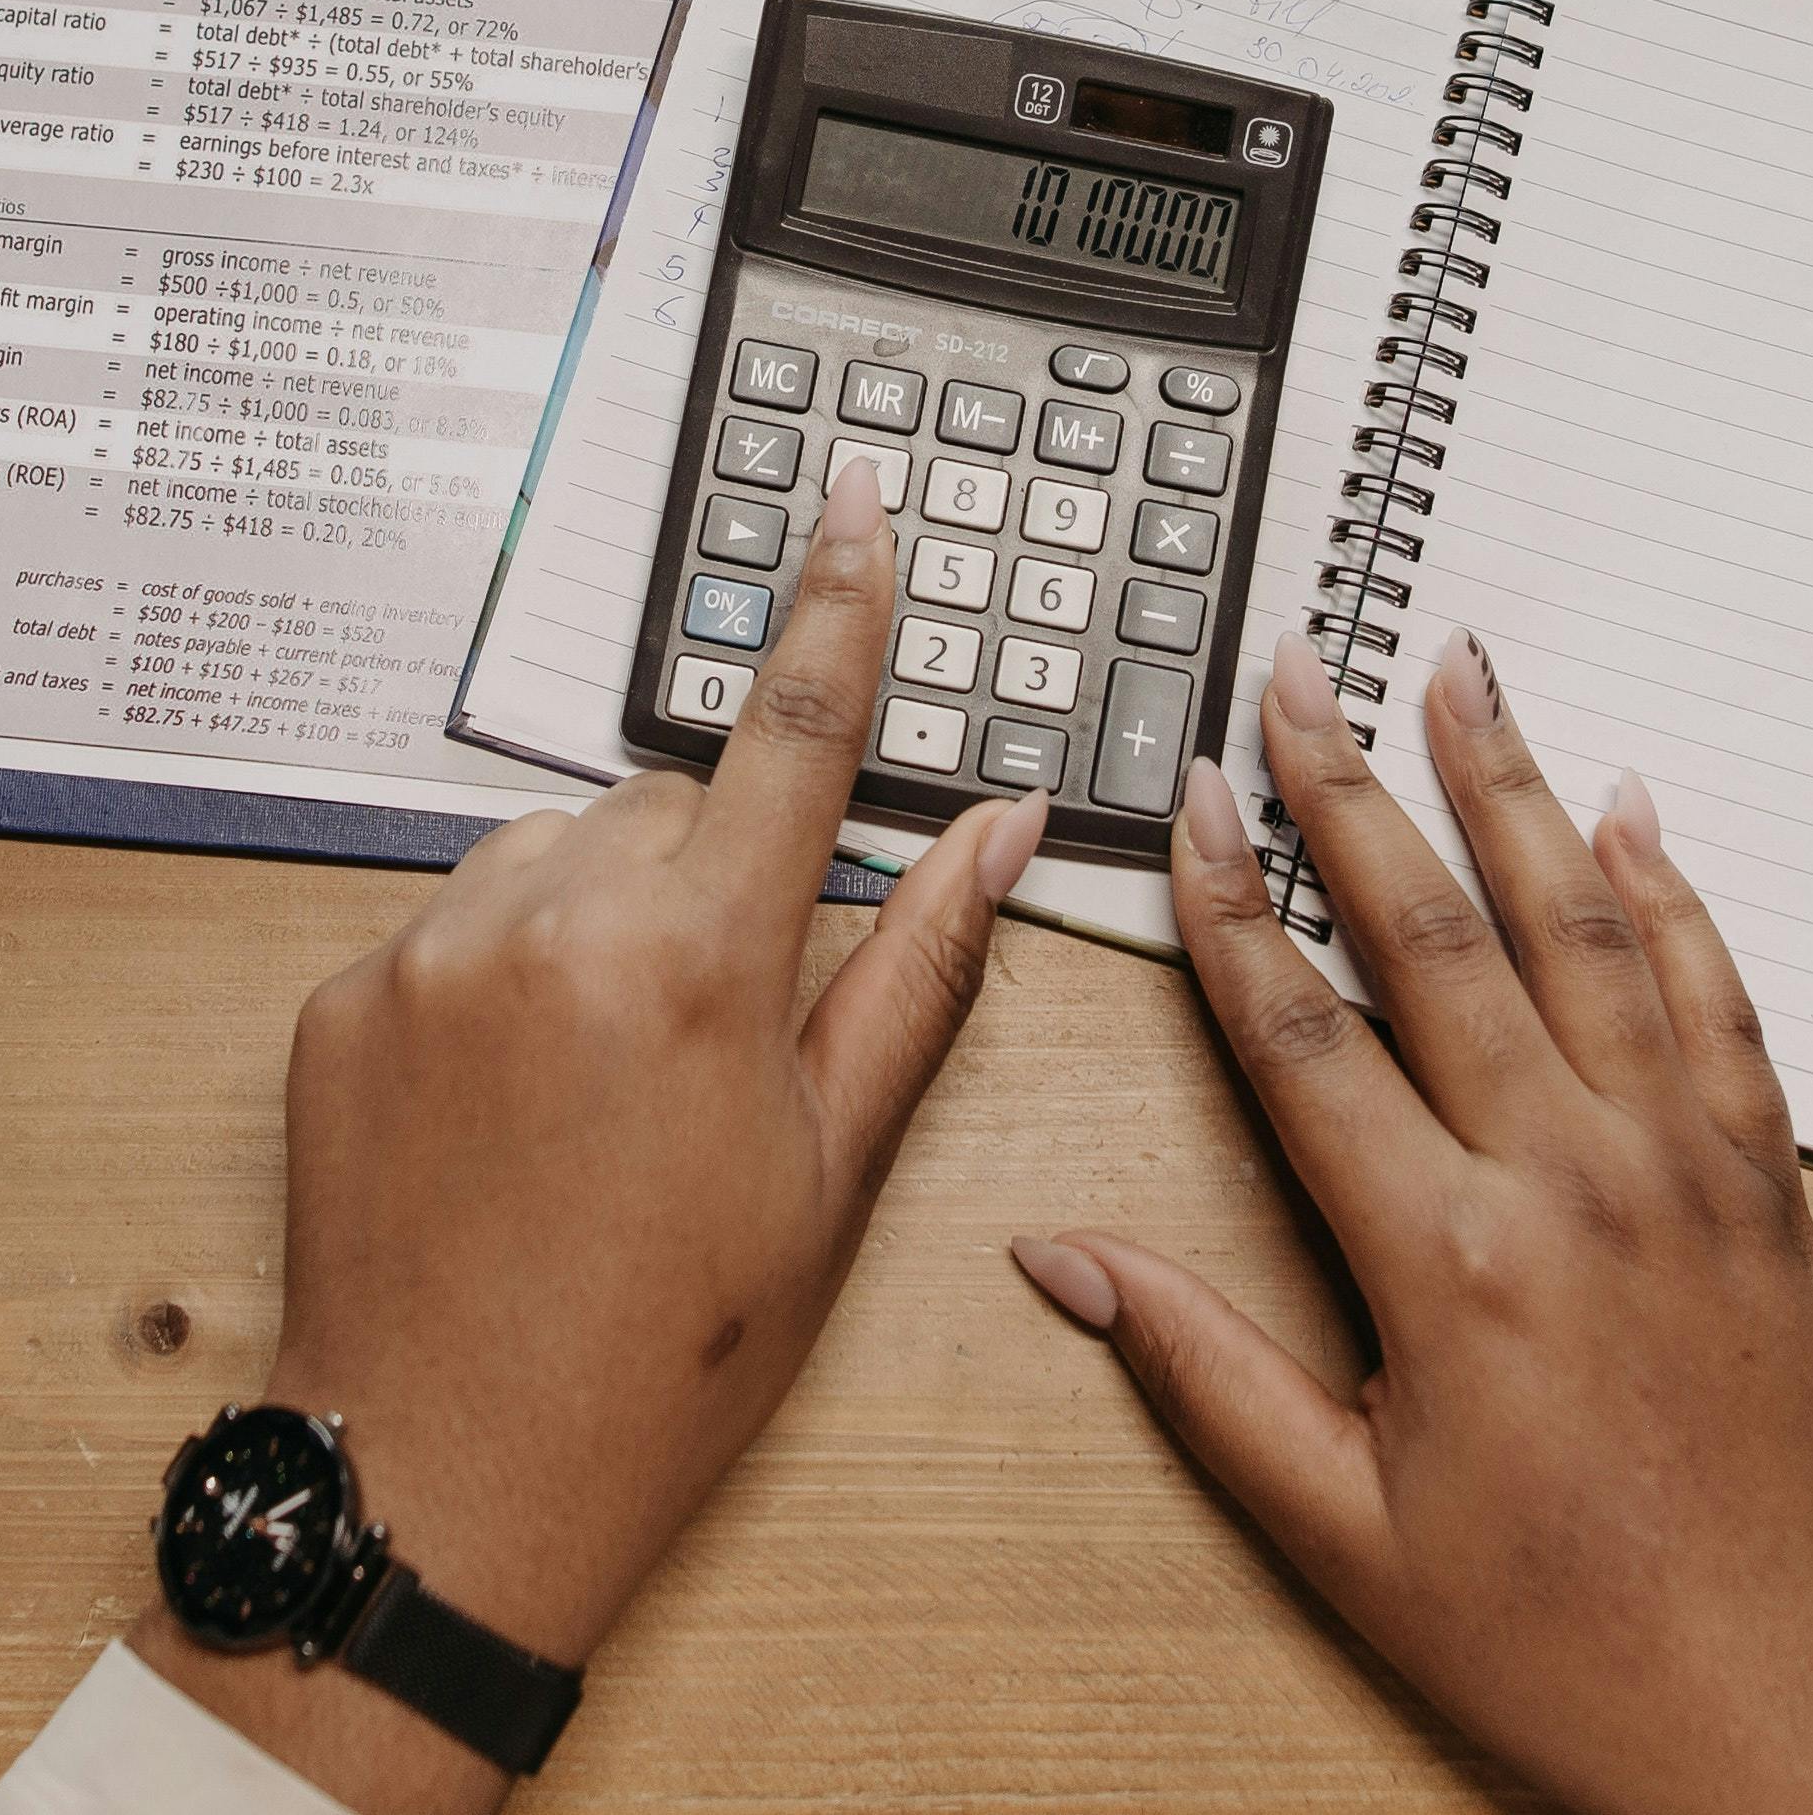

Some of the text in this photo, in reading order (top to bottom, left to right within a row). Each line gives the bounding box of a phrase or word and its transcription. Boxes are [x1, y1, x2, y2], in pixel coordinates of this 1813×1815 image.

[62, 10, 107, 32] ratio
[294, 1, 363, 26] $1,485
[390, 10, 440, 37] 0.72,
[447, 20, 470, 36] or
[475, 18, 519, 41] 72%
[50, 65, 95, 86] ratio
[1029, 80, 1054, 103] 12
[714, 95, 725, 123] 1
[1024, 99, 1052, 118] DGT
[69, 122, 114, 145] ratio
[713, 147, 732, 168] 2
[694, 170, 725, 192] 3
[657, 254, 687, 281] 5
[24, 293, 94, 318] margin
[652, 295, 685, 326] 6
[771, 302, 1009, 363] CORRECT SD-212
[749, 358, 798, 393] MC
[1187, 373, 1213, 403] %
[856, 379, 905, 416] MR
[16, 403, 76, 434] (ROA)
[1051, 418, 1105, 452] M+
[6, 462, 65, 492] (ROE)
[953, 478, 978, 512] 8
[1055, 498, 1077, 531] 9
[939, 556, 962, 590] 5
[1039, 576, 1062, 610] 6
[923, 636, 948, 673] 2
[1026, 656, 1049, 690] 3
[701, 676, 725, 710] 0
